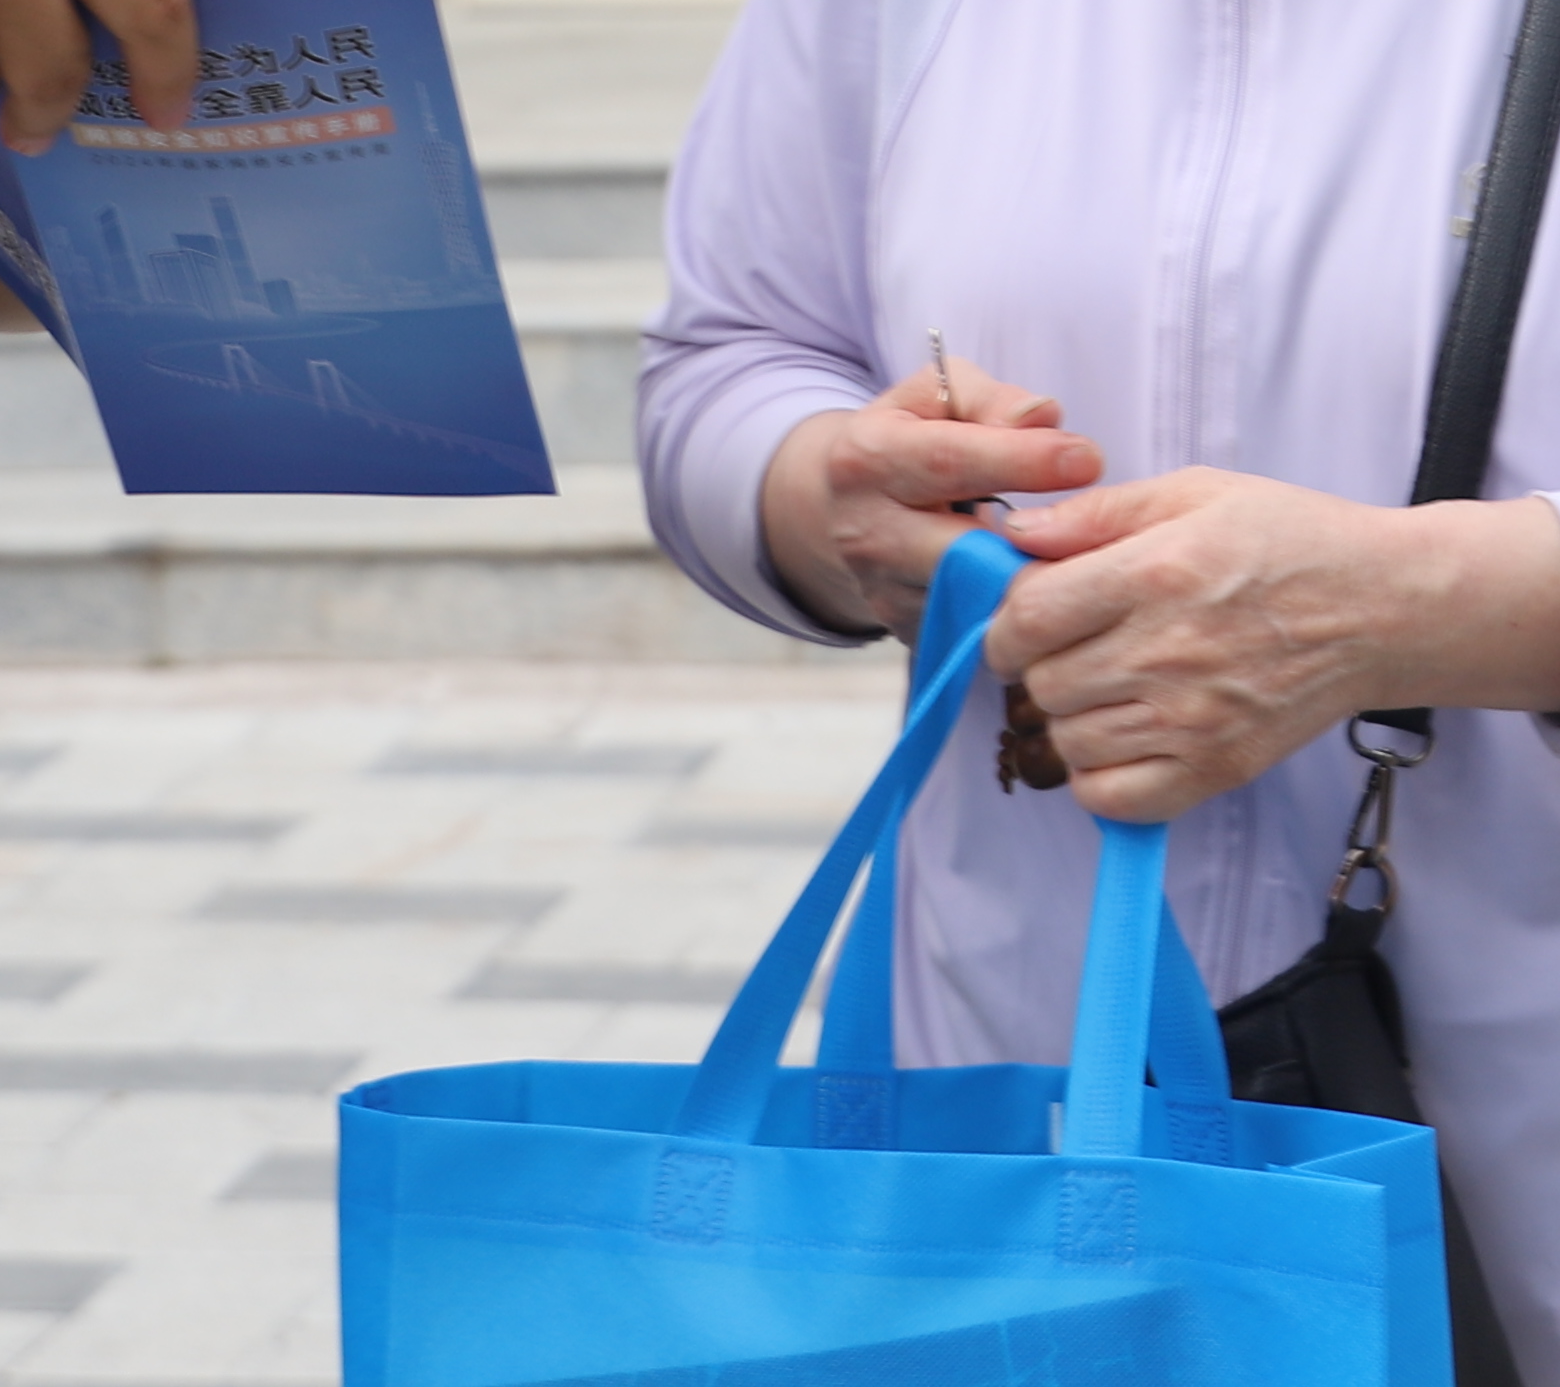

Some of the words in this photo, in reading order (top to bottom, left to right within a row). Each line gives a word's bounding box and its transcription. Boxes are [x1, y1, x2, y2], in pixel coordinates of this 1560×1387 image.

[74, 65, 386, 121] 网络全靠人民
